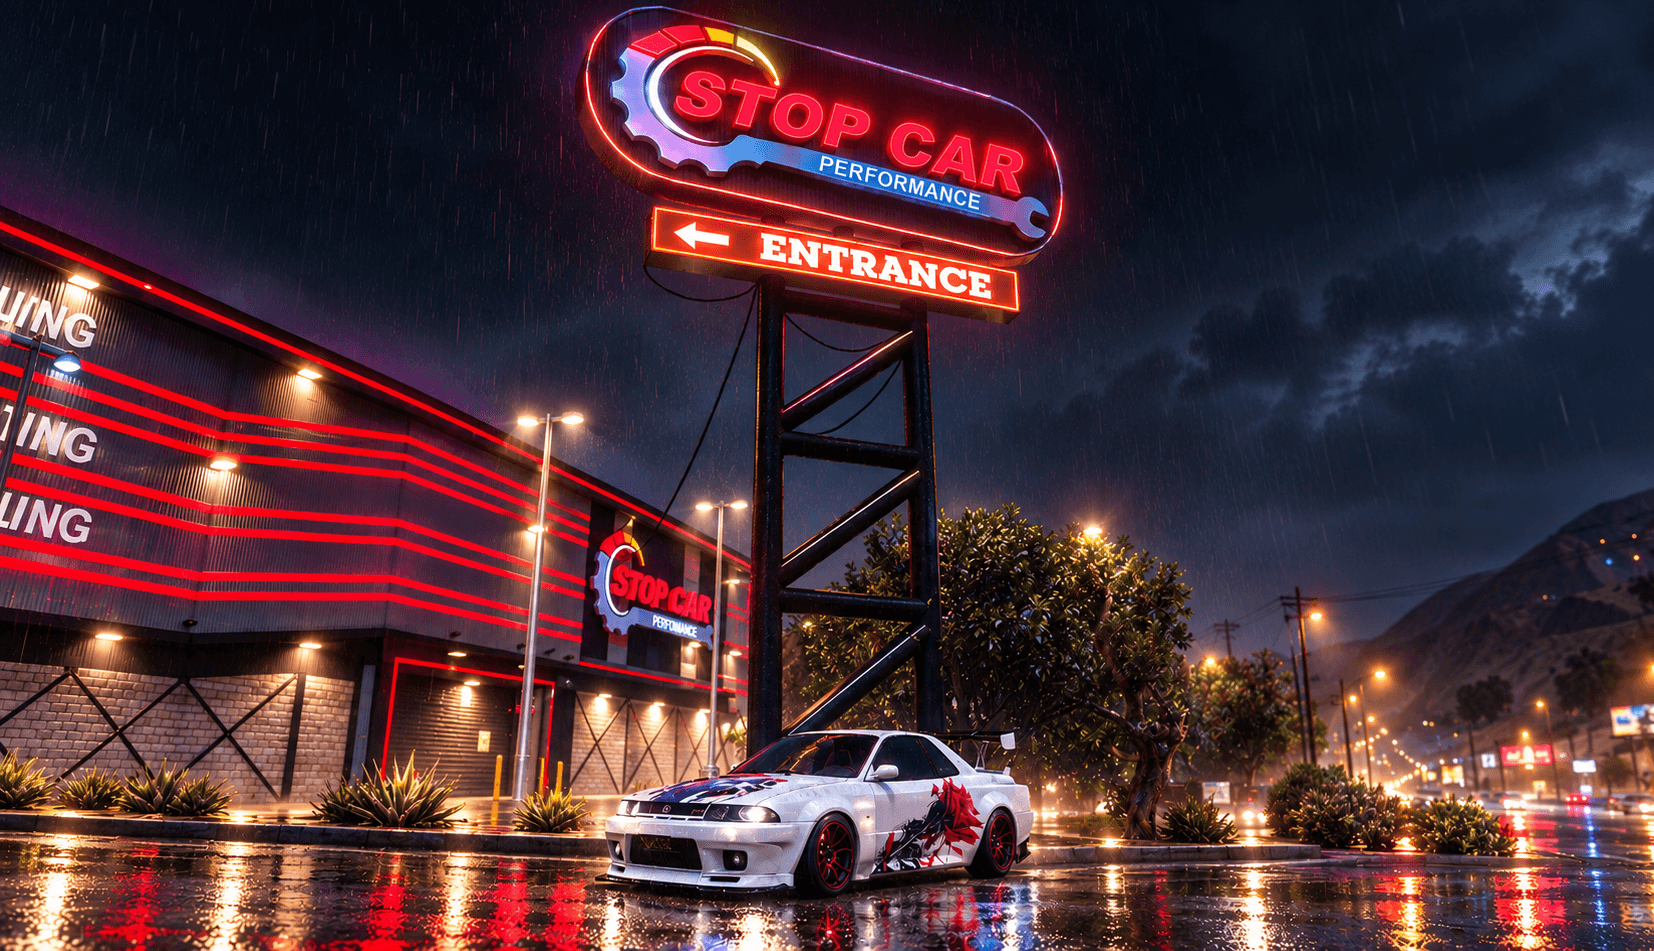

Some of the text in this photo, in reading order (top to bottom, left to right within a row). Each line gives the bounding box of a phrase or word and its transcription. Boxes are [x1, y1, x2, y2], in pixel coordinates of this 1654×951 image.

[674, 70, 1024, 195] STOP CAR
[818, 155, 981, 210] PERFORMANCE
[760, 232, 992, 300] ENTRANCE
[610, 564, 712, 623] STOP CAR
